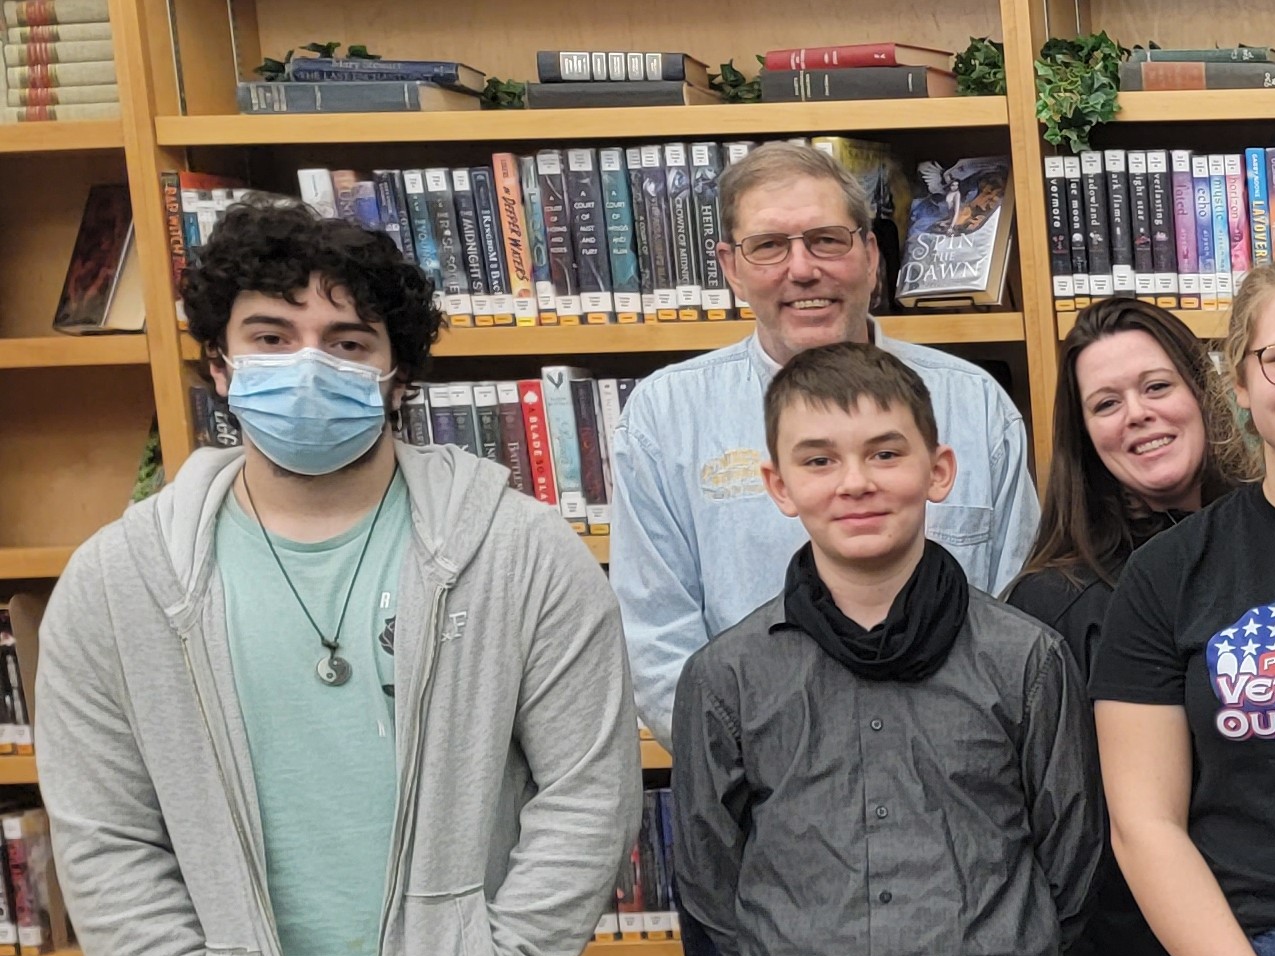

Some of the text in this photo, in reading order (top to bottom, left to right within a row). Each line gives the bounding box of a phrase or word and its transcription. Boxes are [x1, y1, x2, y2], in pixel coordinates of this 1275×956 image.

[1112, 194, 1123, 223] flame
[1228, 174, 1240, 220] horizon
[502, 195, 522, 238] DEEPER
[673, 196, 686, 233] CROWN
[1071, 204, 1081, 229] moon
[677, 234, 686, 246] OF
[700, 204, 719, 288] HEIR OF FIRE
[911, 232, 975, 261] SPIN
[507, 237, 529, 282] WATERS
[903, 258, 987, 284] DAWN
[932, 252, 956, 263] THE
[528, 415, 543, 457] BLADE
